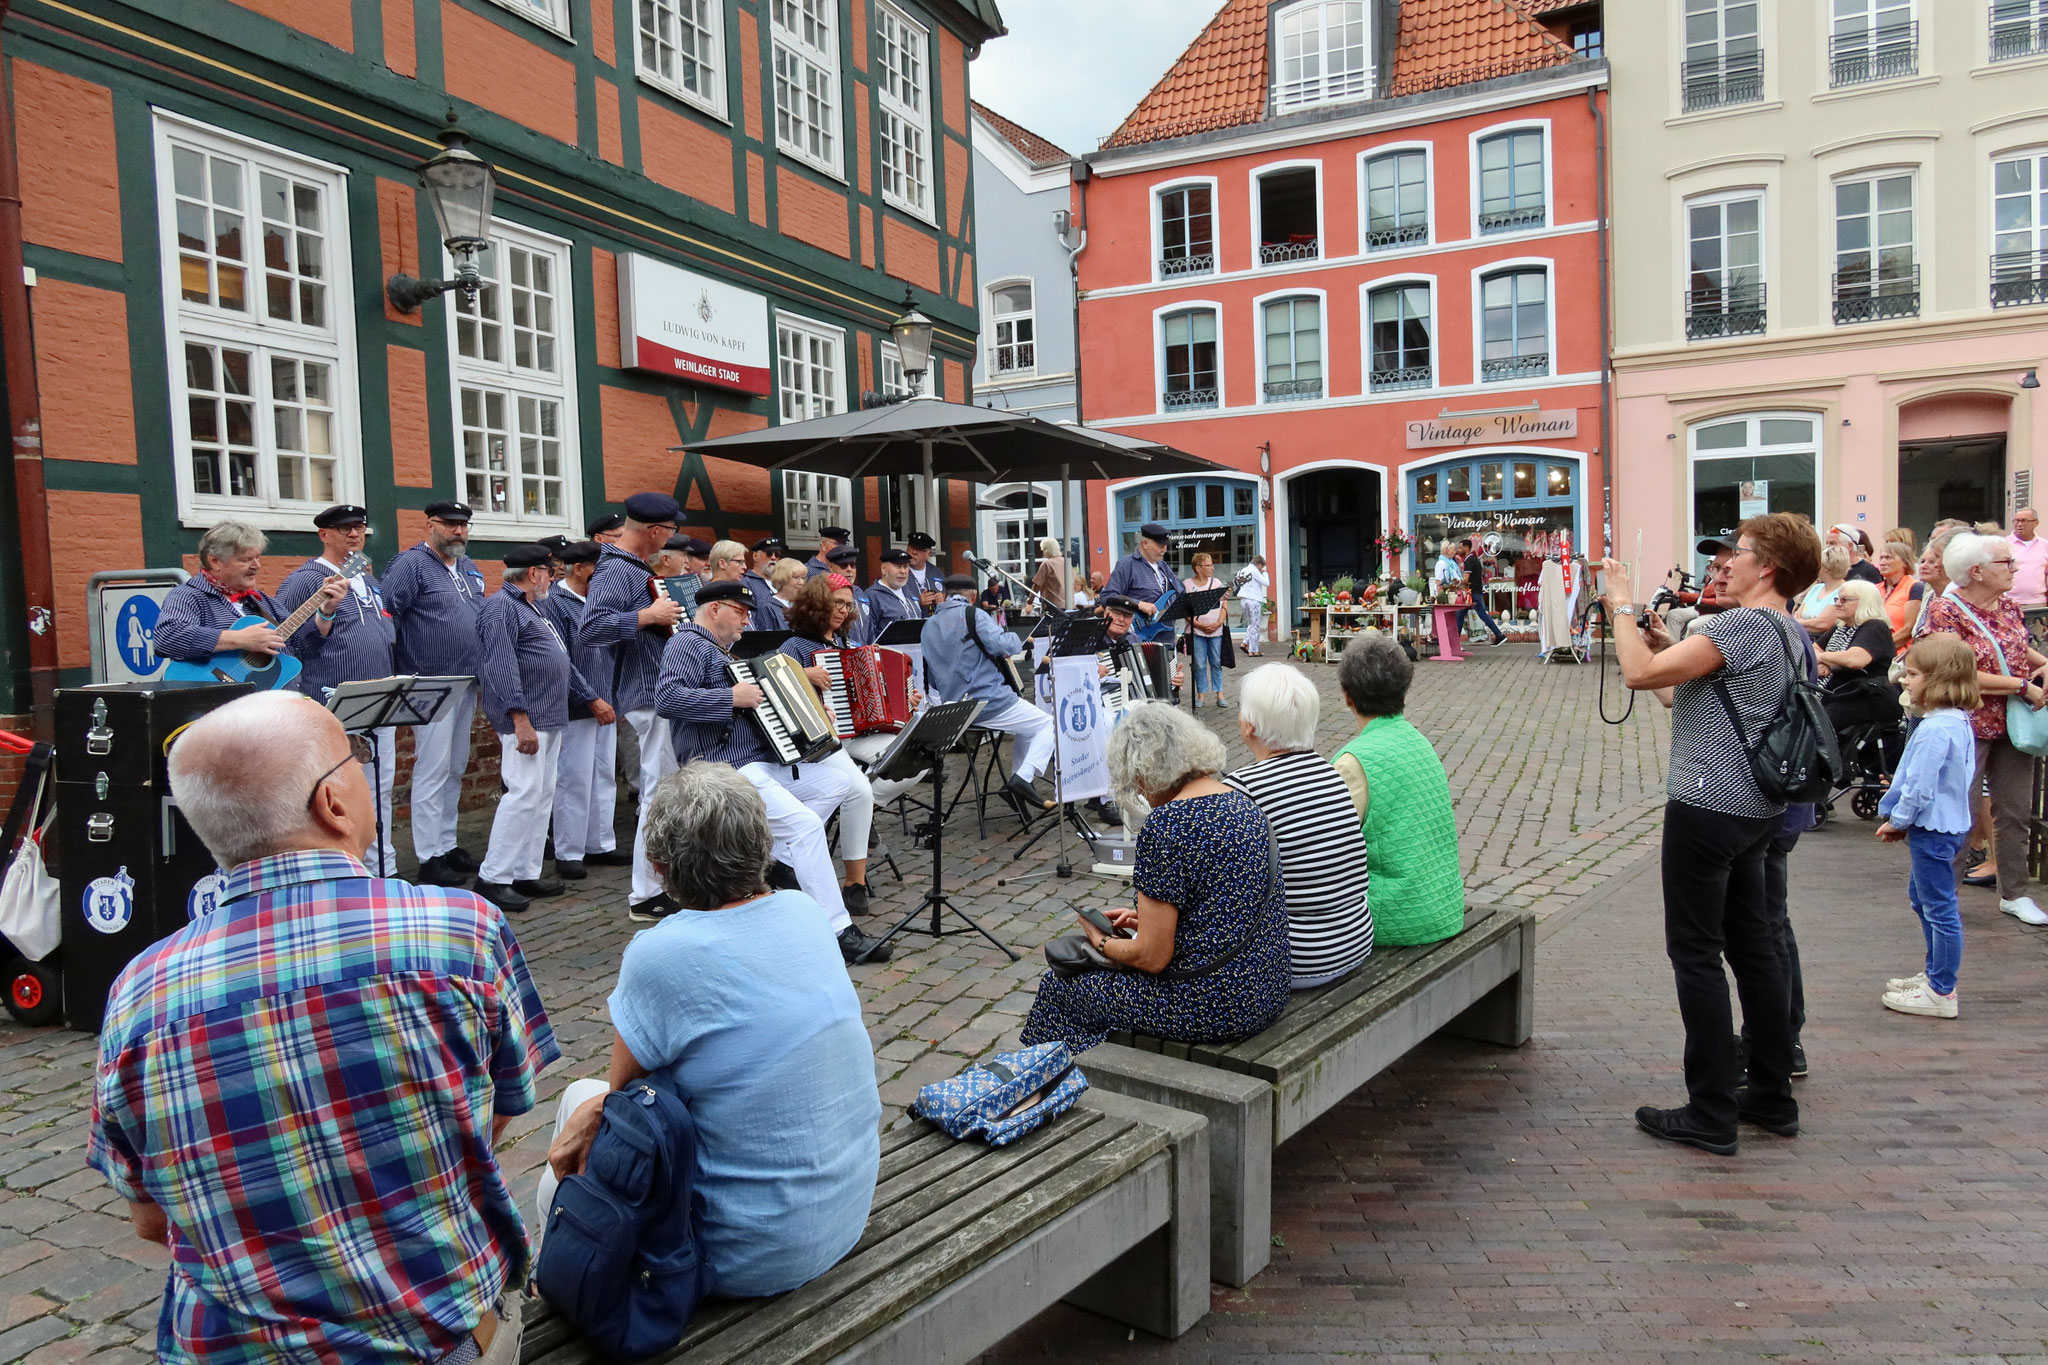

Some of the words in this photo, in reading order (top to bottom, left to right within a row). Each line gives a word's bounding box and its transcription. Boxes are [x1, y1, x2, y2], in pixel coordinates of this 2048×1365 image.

[663, 320, 700, 339] LUDWIG
[701, 330, 719, 345] VON
[674, 357, 717, 377] WEINLAGER
[718, 367, 740, 383] STADE
[1408, 421, 1486, 446] Vintage
[1494, 414, 1574, 436] Woman
[1440, 515, 1492, 531] Vintage
[1493, 513, 1547, 528] Woman
[1561, 547, 1571, 588] SALE
